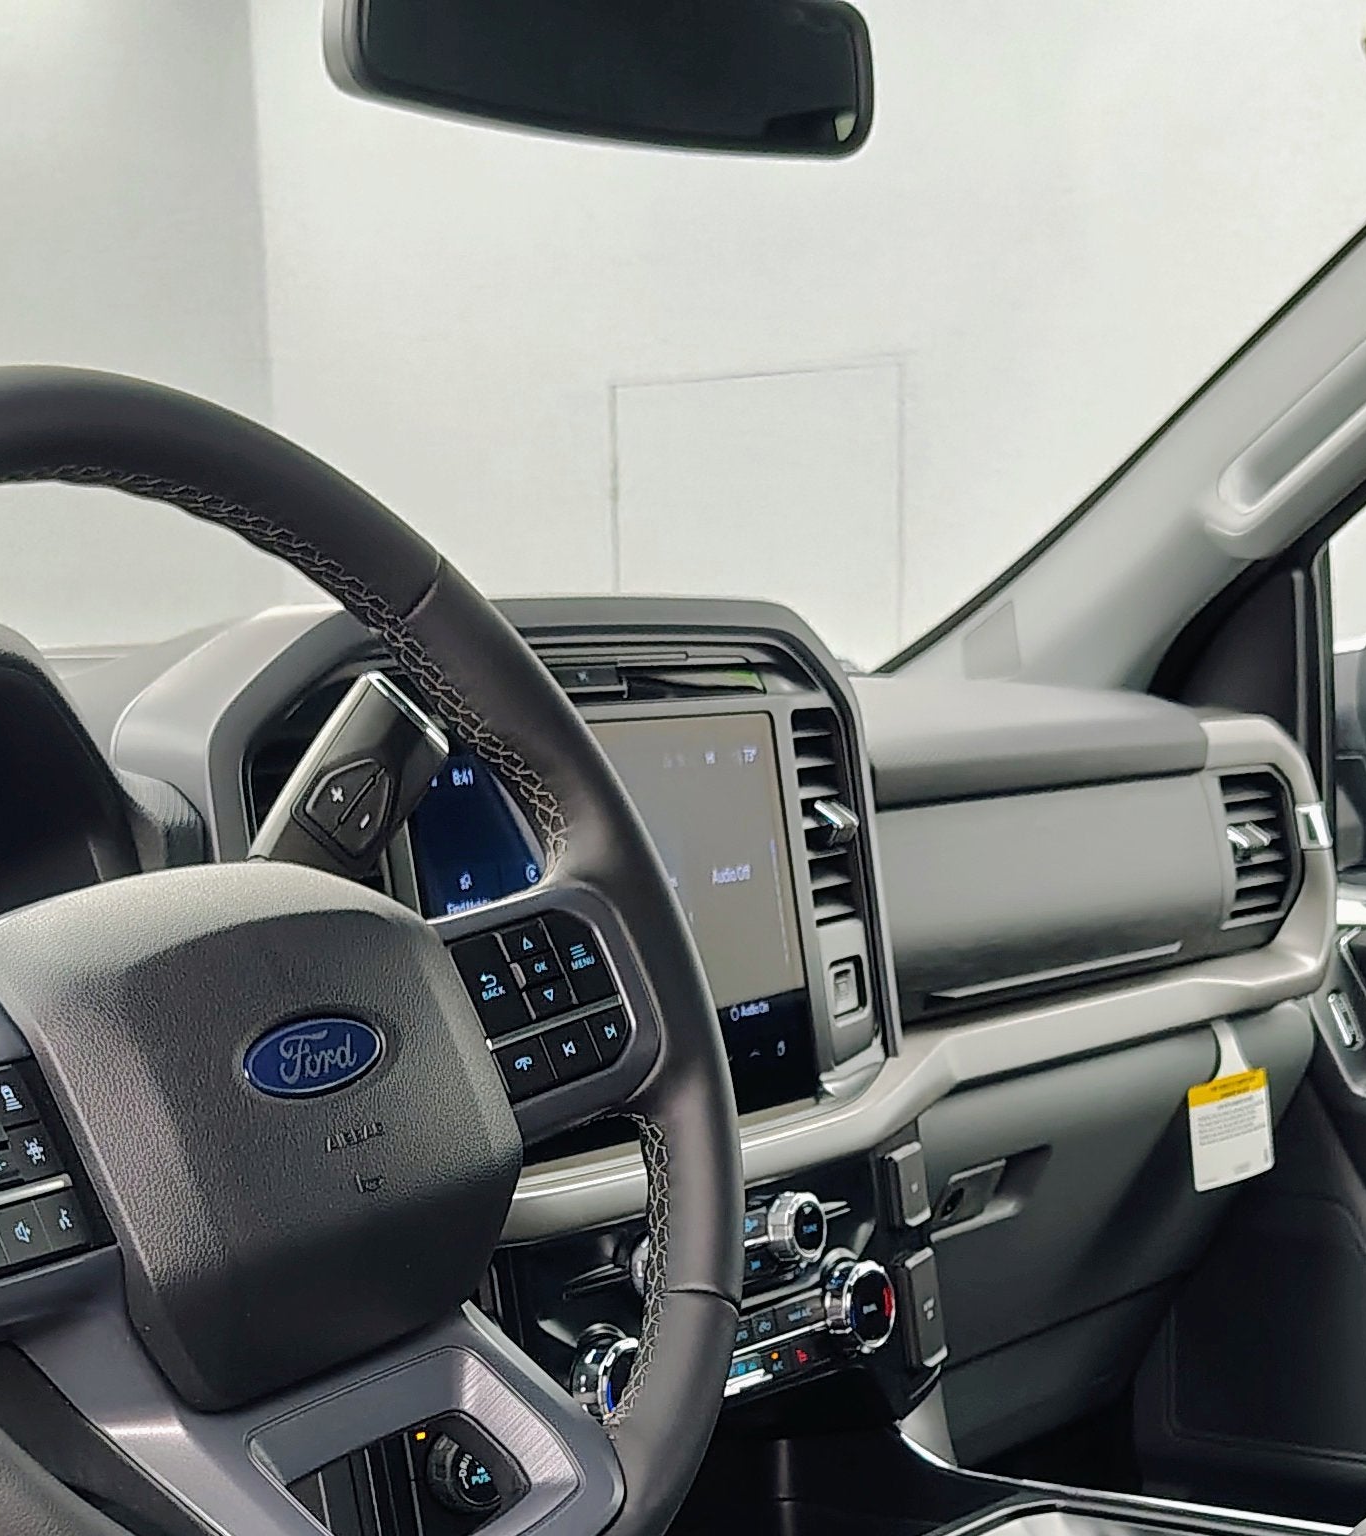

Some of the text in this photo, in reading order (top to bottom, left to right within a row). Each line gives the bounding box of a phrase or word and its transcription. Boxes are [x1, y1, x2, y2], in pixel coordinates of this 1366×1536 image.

[451, 767, 474, 787] 8:41
[534, 961, 548, 974] OK
[570, 955, 596, 971] MENU
[481, 986, 507, 1001] BACK
[279, 1029, 358, 1085] Ford
